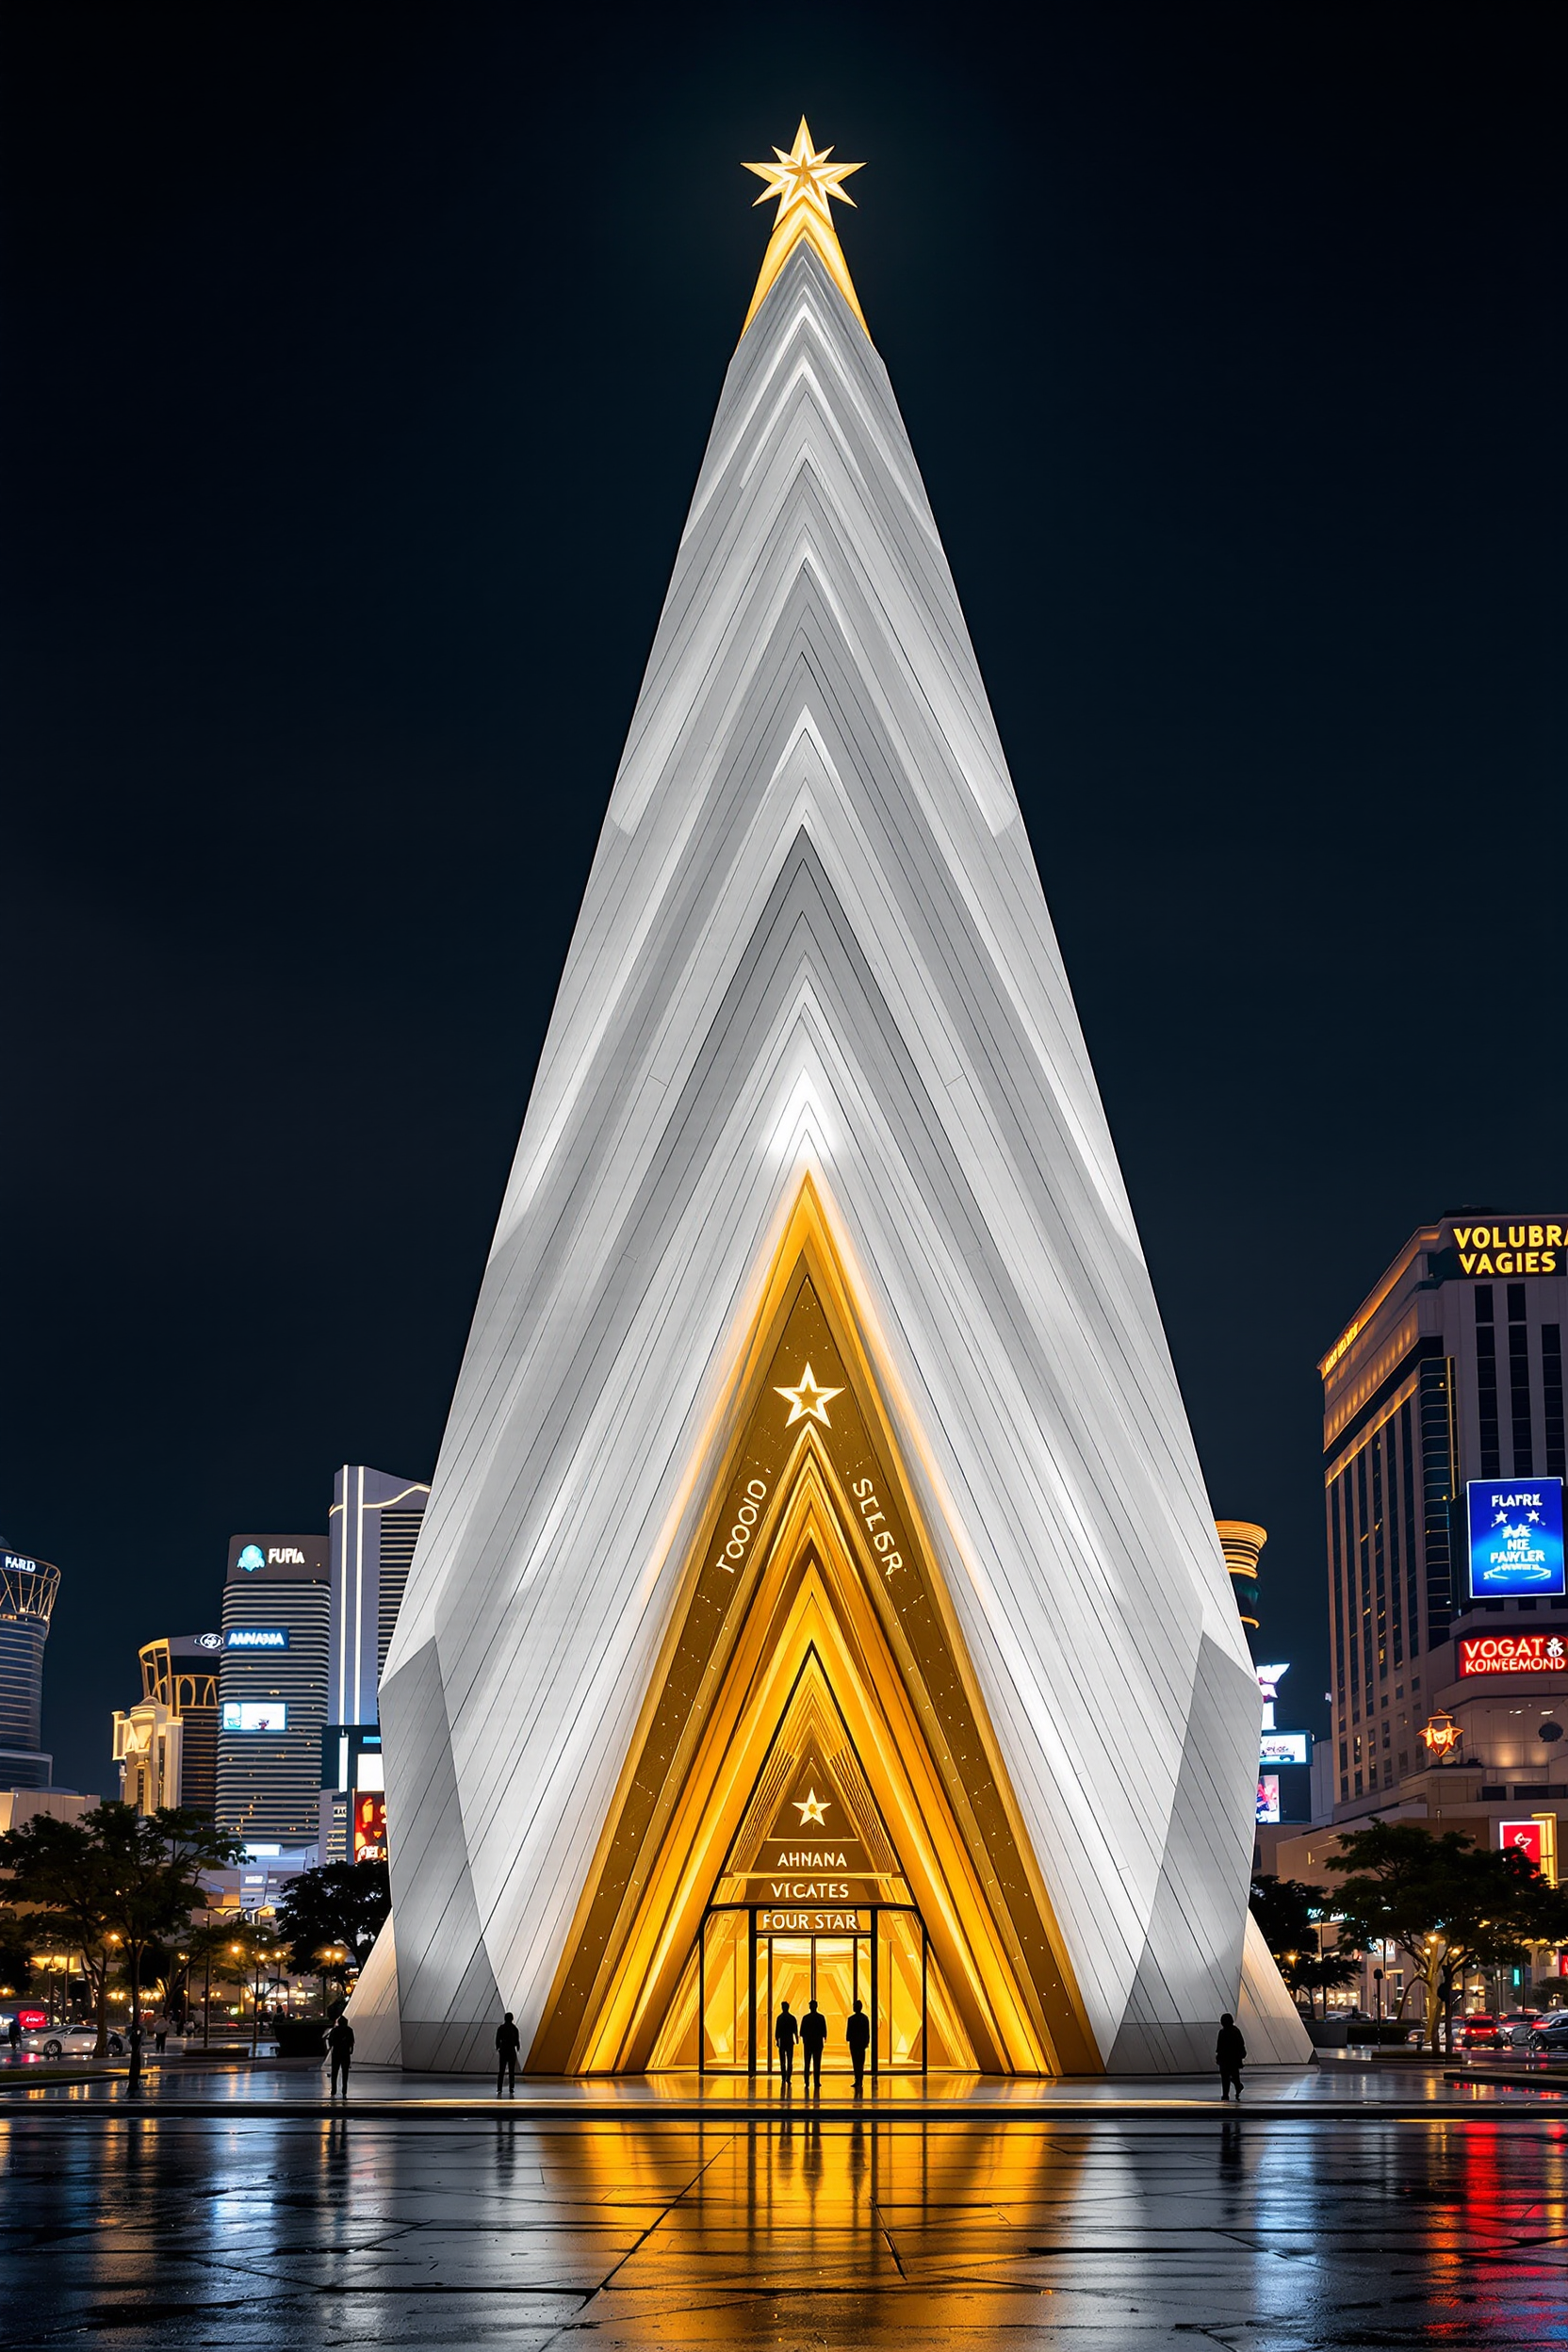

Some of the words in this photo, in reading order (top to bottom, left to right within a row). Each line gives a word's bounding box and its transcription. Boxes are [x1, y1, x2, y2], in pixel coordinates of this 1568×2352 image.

[1453, 1224, 1568, 1250] VOLUBR
[1459, 1251, 1557, 1274] VAGIES
[1463, 1638, 1544, 1658] VOGAT
[776, 1852, 848, 1868] AHNANA
[771, 1882, 849, 1899] VICATES
[762, 1914, 809, 1930] FOUR
[814, 1914, 858, 1930] STAR
